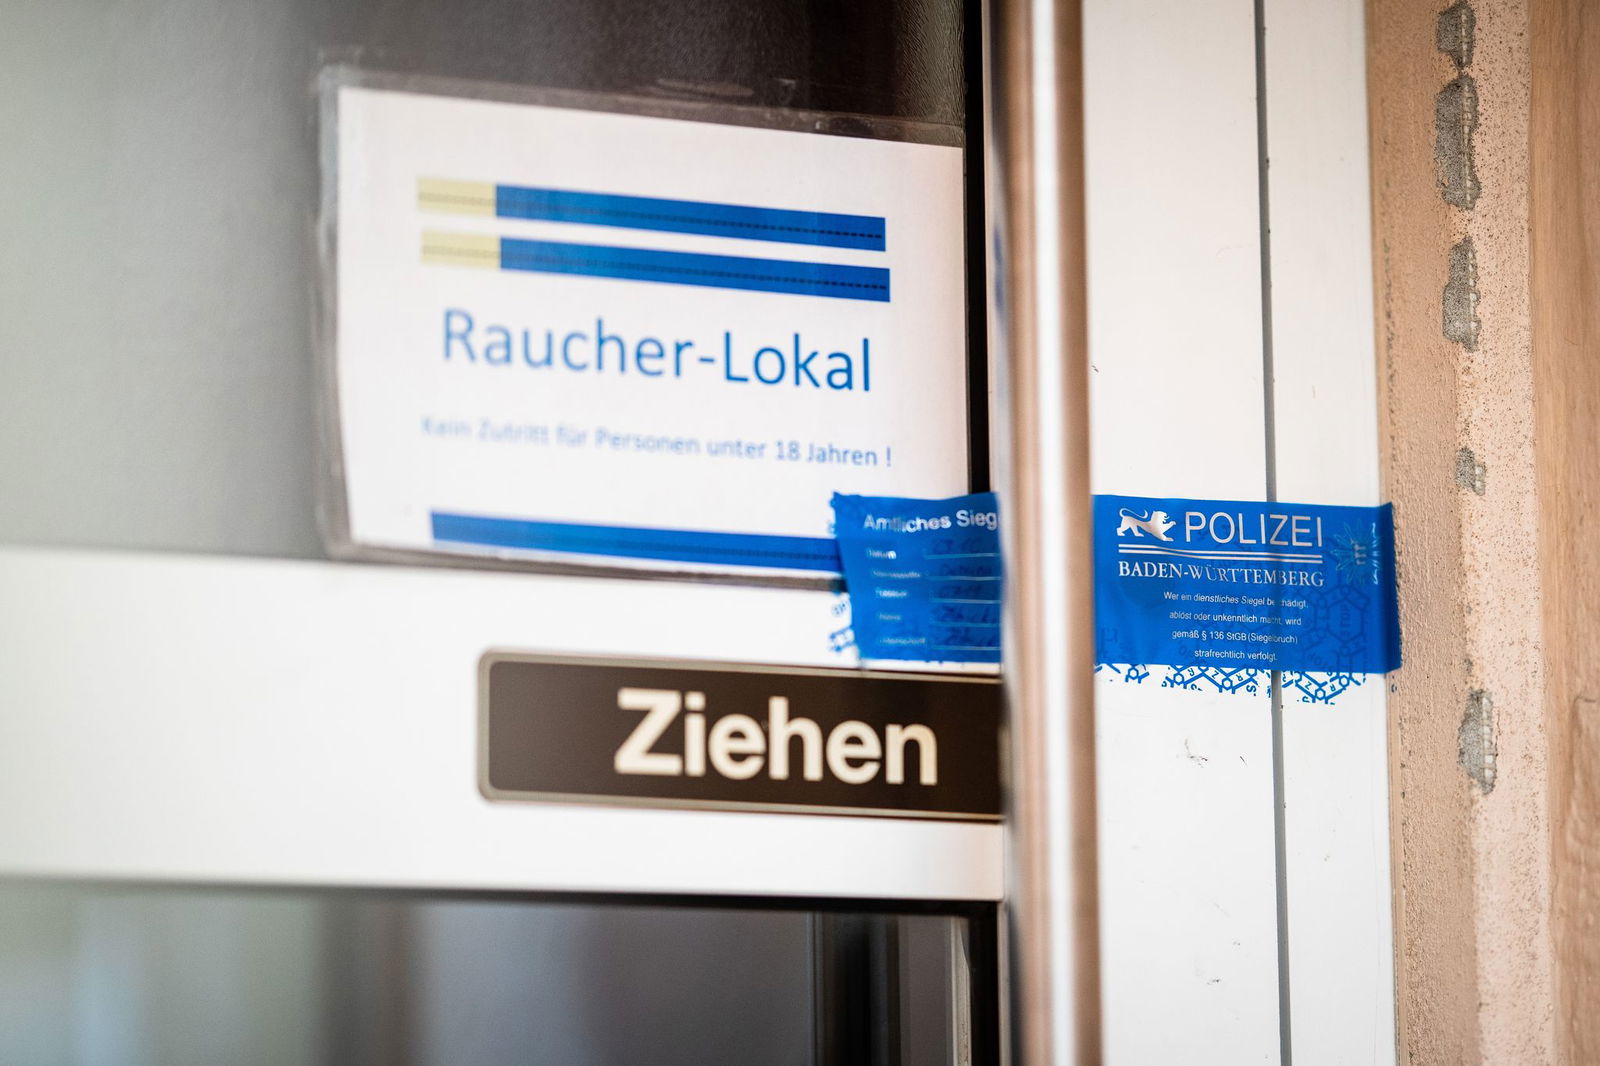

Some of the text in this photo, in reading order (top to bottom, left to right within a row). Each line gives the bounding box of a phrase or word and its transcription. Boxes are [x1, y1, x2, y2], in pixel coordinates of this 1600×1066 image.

[443, 307, 871, 393] Raucher-Lokal
[477, 418, 550, 445] Zutritt
[555, 426, 589, 449] für
[594, 427, 700, 456] Personen
[706, 437, 767, 461] unter
[775, 440, 801, 462] 18
[806, 443, 878, 467] Jahren
[955, 508, 998, 532] Sieg
[1185, 510, 1323, 548] POLIZEI
[1117, 560, 1325, 588] BADEN-WÜRTTEMBERG
[1163, 591, 1180, 601] Wer
[1193, 593, 1240, 604] dienstliches
[1241, 595, 1265, 607] Siegel
[1193, 612, 1210, 621] oder
[1212, 613, 1258, 623] unkenntlich
[1285, 617, 1302, 626] wird
[1171, 629, 1200, 640] gemäß
[1209, 630, 1225, 640] 136
[1226, 631, 1247, 641] StGB
[1194, 648, 1246, 660] strafrechtlich
[613, 686, 939, 786] Ziehen
